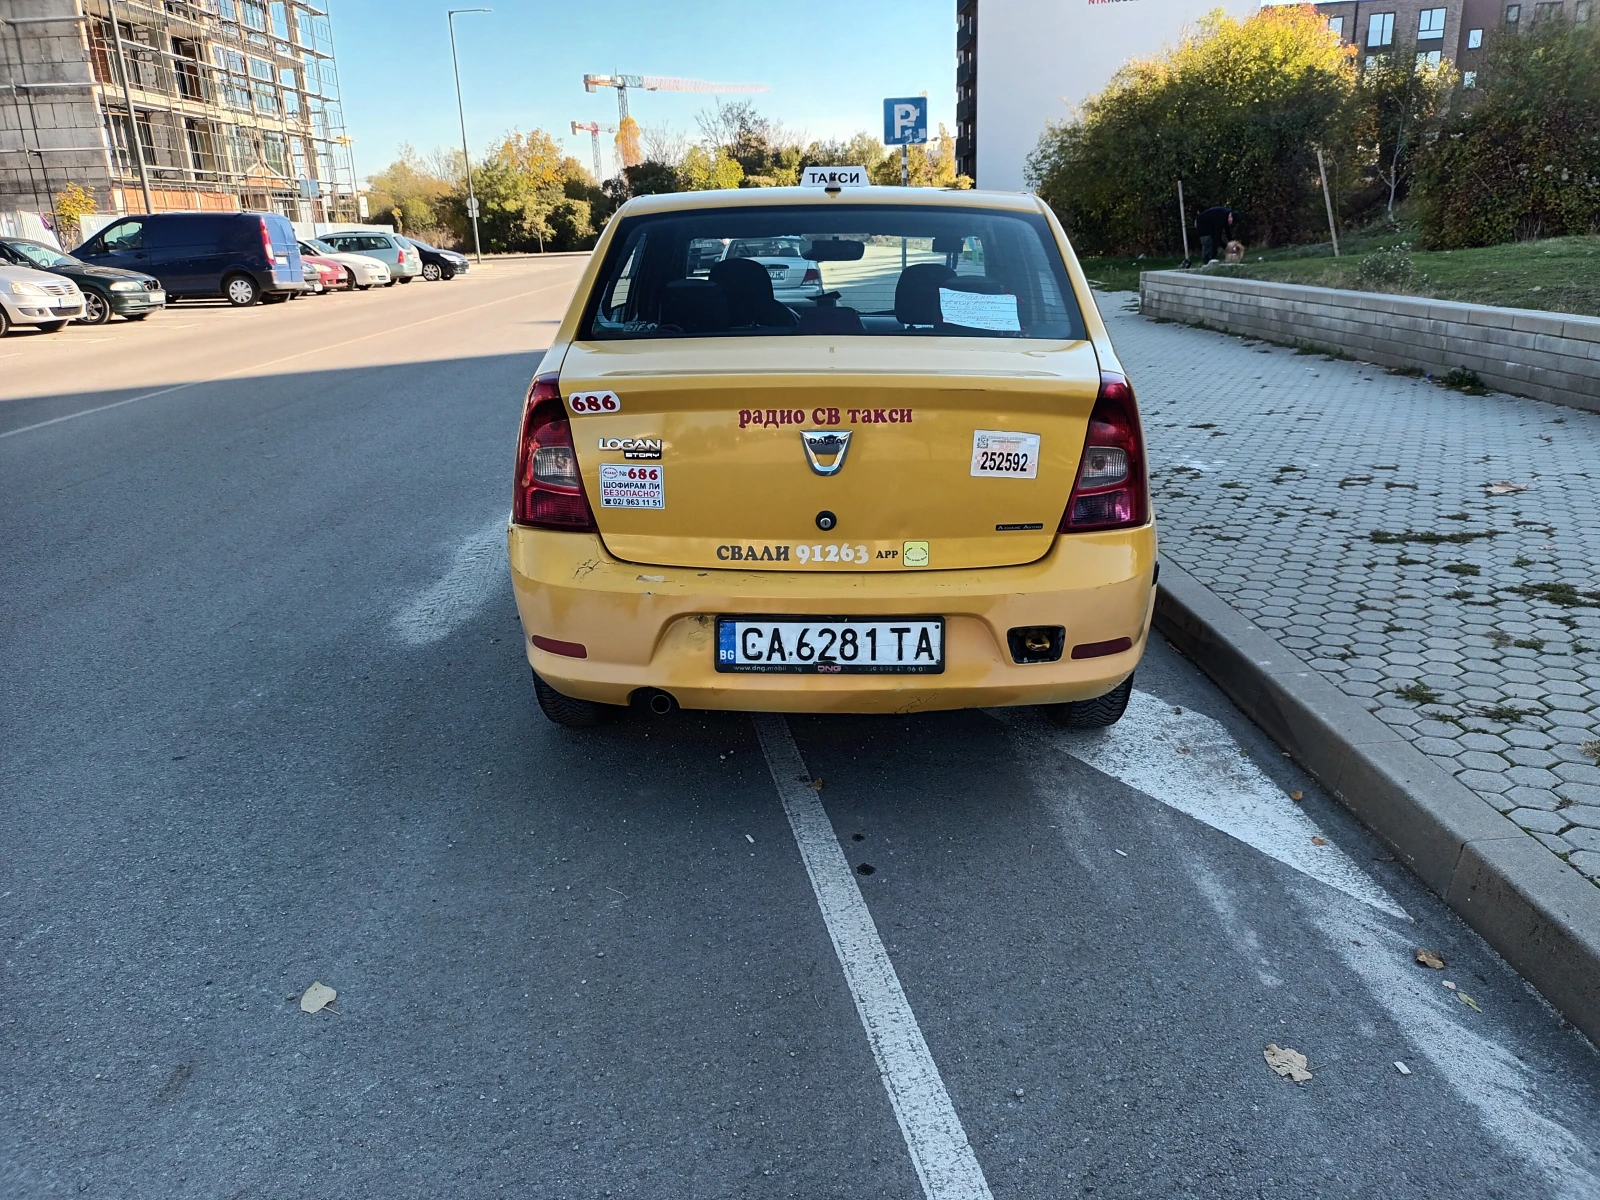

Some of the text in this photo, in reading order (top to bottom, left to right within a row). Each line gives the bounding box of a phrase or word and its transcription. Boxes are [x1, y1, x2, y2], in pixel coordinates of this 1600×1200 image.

[894, 104, 917, 138] P
[572, 394, 617, 412] 686
[738, 407, 913, 429] радио СВ такси
[598, 437, 662, 452] LOGAN
[980, 451, 1029, 472] 252592
[628, 467, 659, 481] 686
[603, 481, 660, 490] ШОФИРАМ ЛИ
[603, 489, 661, 497] БЕЗОПАСНО?
[625, 498, 640, 506] 963
[652, 499, 661, 507] 51
[716, 545, 790, 561] СВАЛИ
[795, 543, 870, 564] 91263
[876, 550, 899, 559] APP
[719, 649, 735, 660] BG
